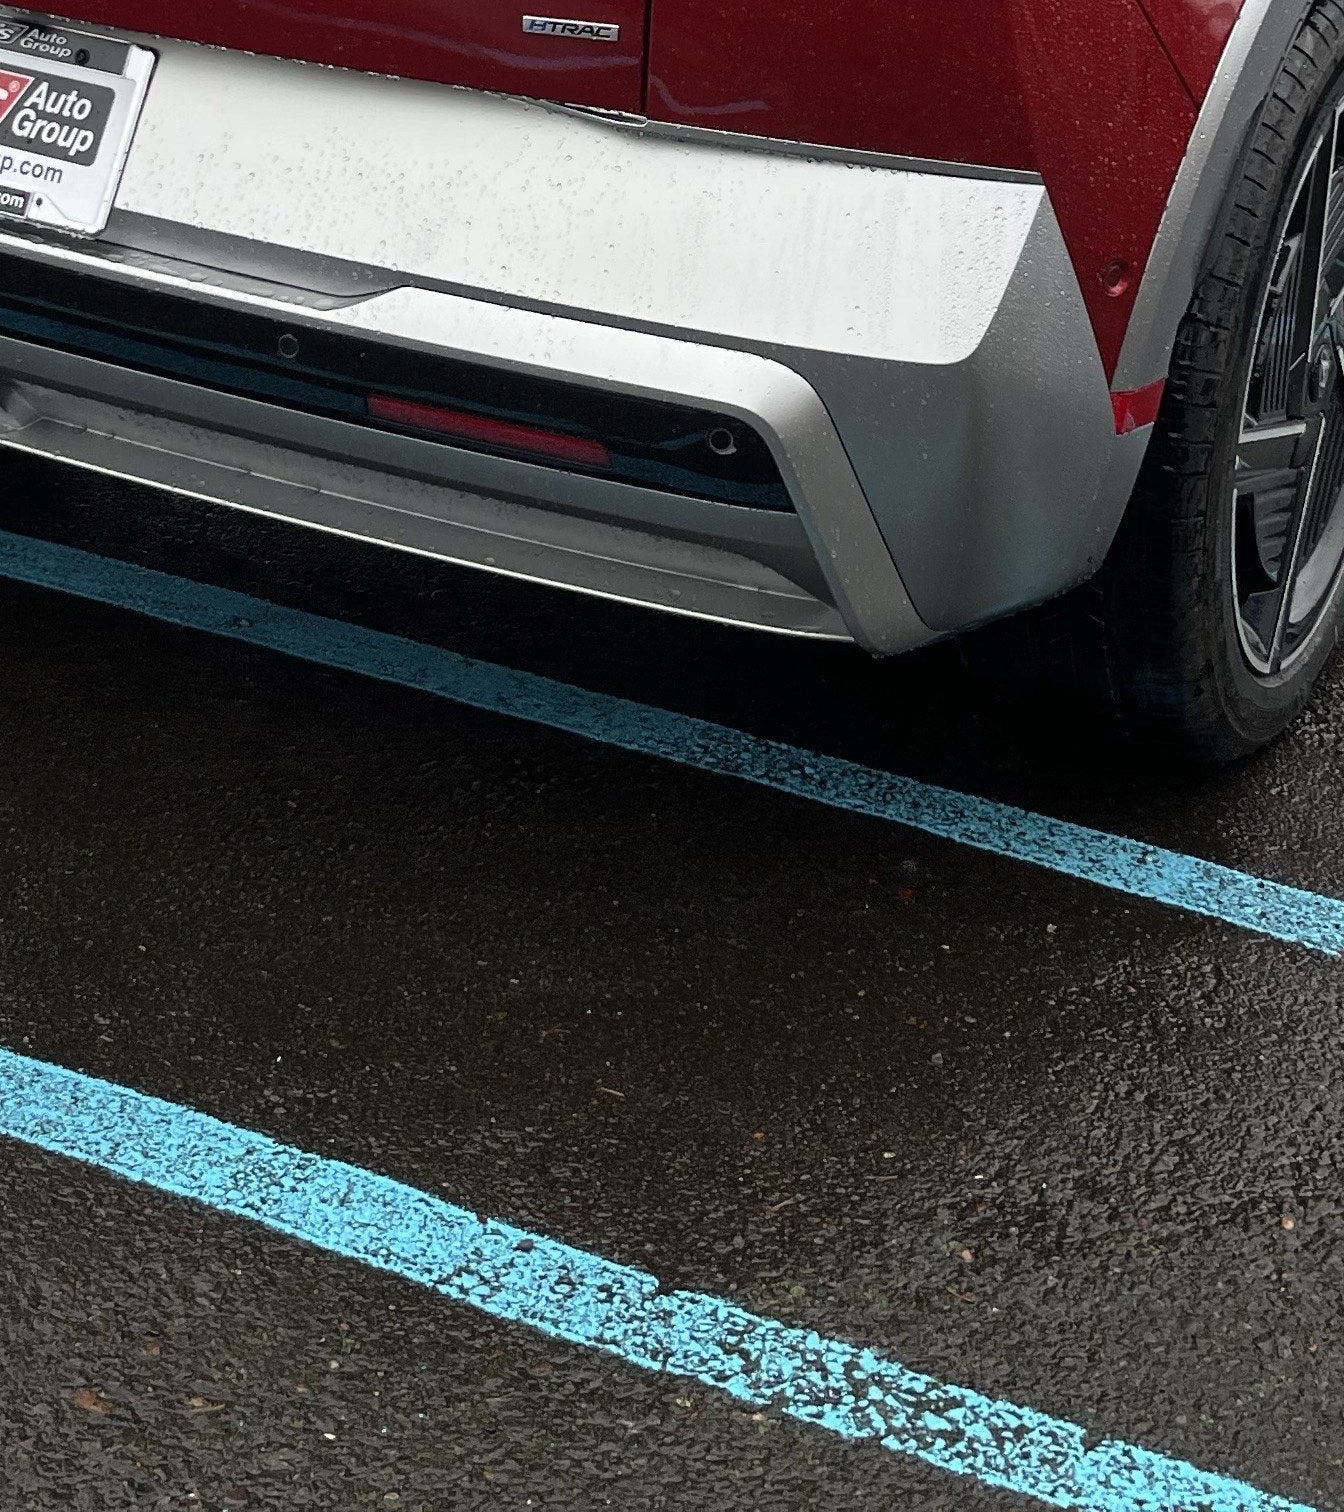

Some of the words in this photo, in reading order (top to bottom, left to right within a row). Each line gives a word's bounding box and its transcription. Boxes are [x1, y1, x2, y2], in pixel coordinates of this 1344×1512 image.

[25, 28, 68, 45] Auto
[528, 19, 612, 38] HTRAC
[19, 37, 73, 58] Group
[23, 82, 93, 121] Auto
[11, 107, 96, 157] Group
